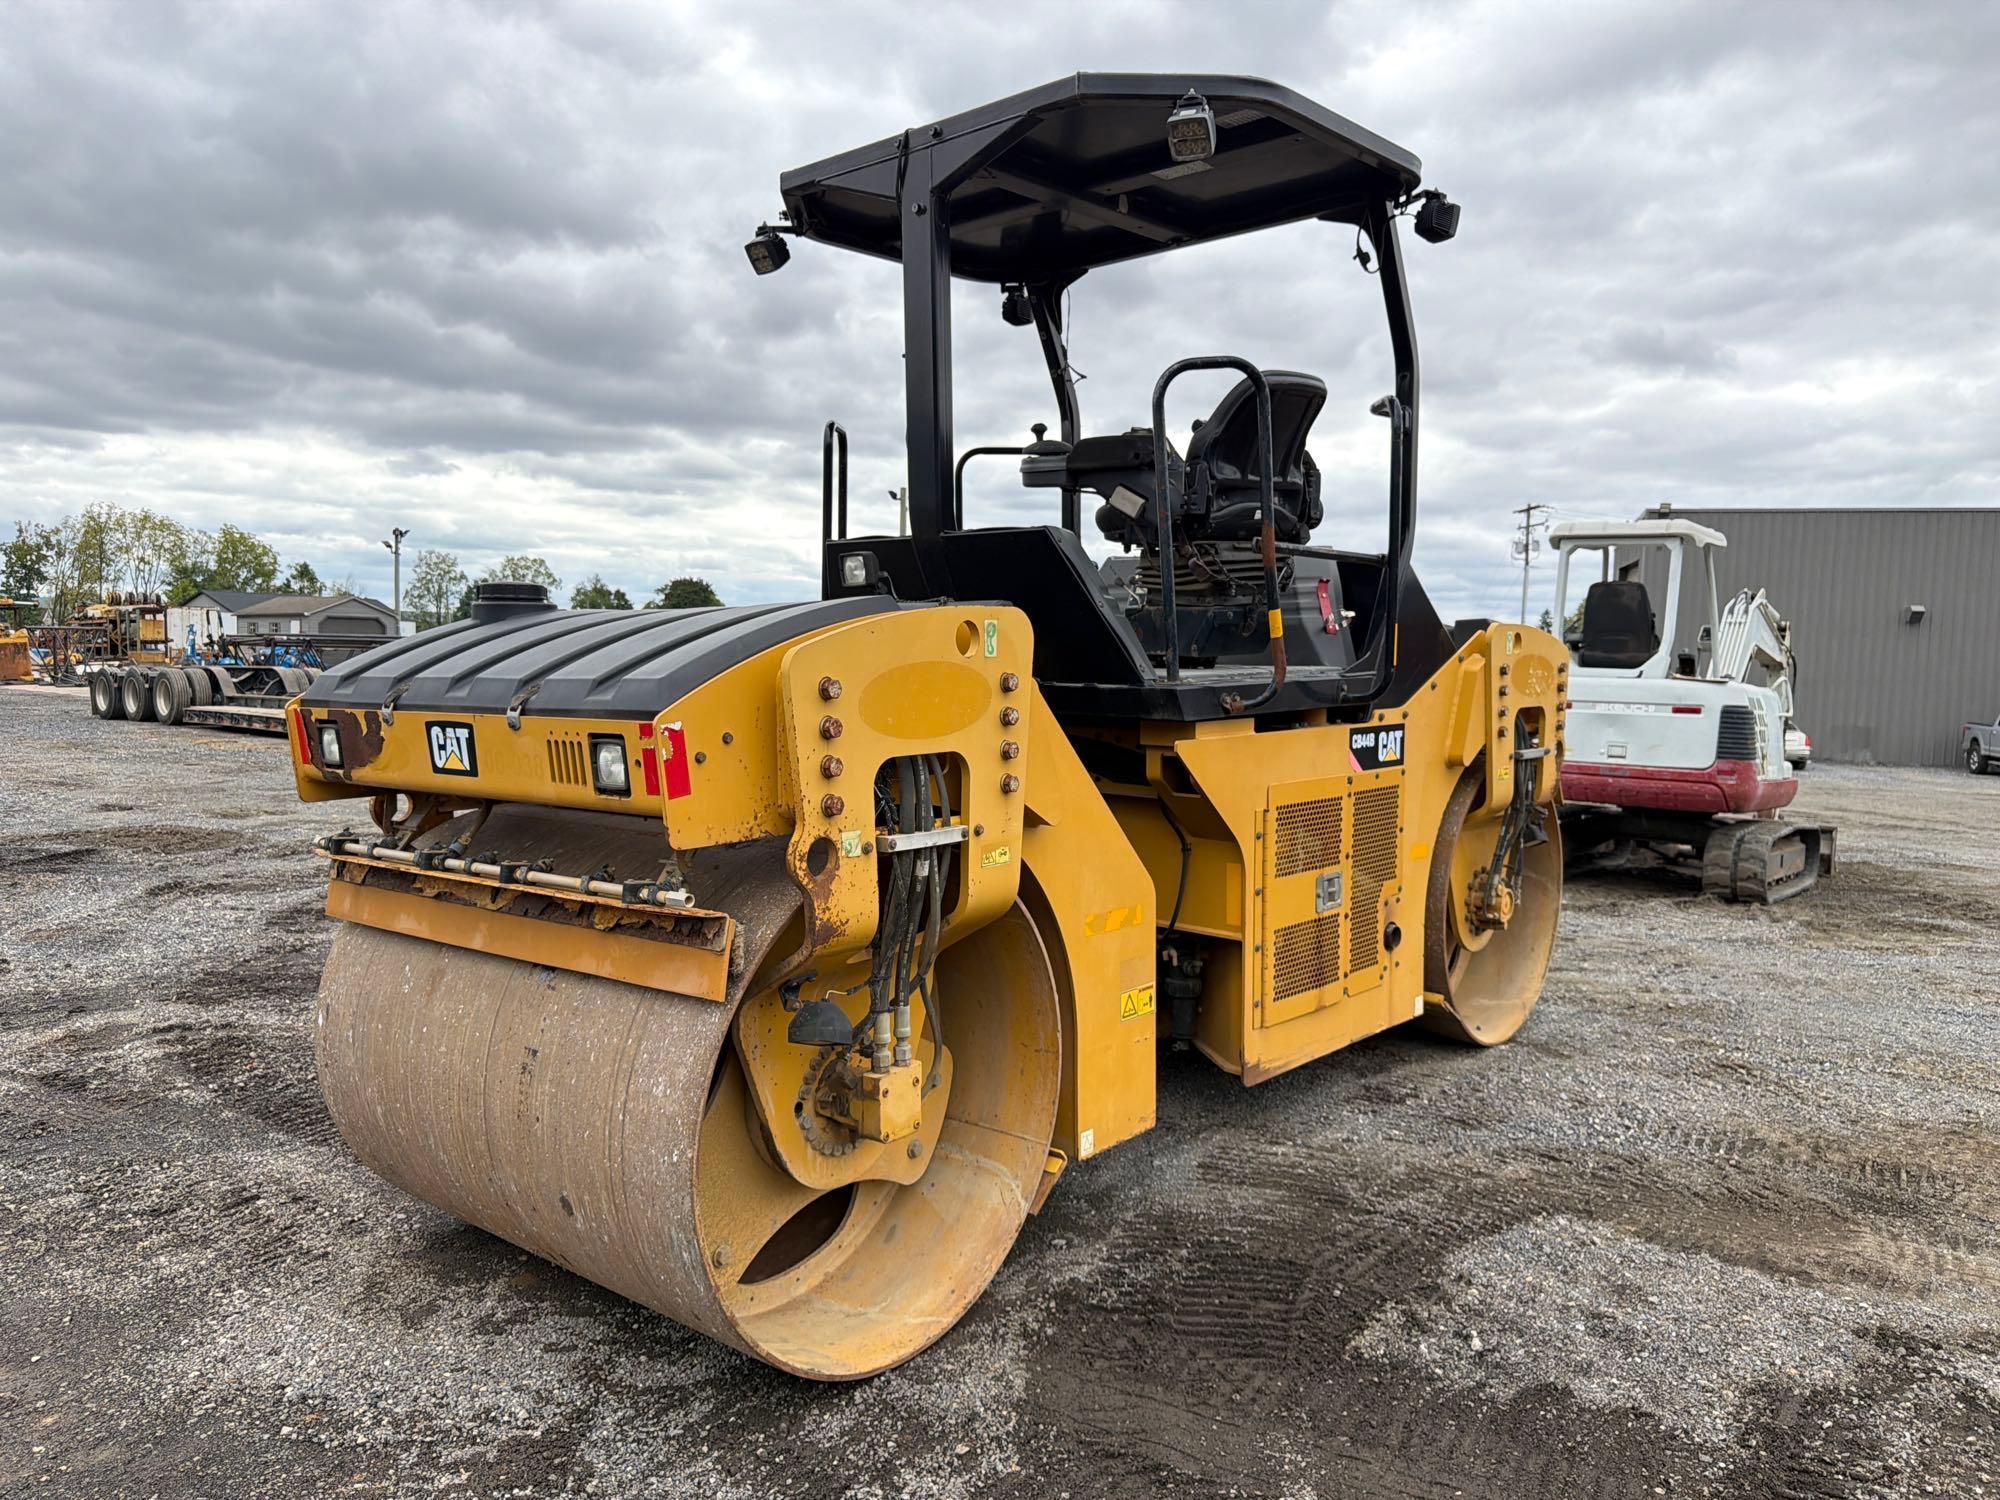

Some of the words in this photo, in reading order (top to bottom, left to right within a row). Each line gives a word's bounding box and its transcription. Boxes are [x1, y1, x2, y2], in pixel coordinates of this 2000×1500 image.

[430, 725, 470, 771] CAT
[1352, 732, 1375, 749] CB44B
[1378, 730, 1403, 762] CAT
